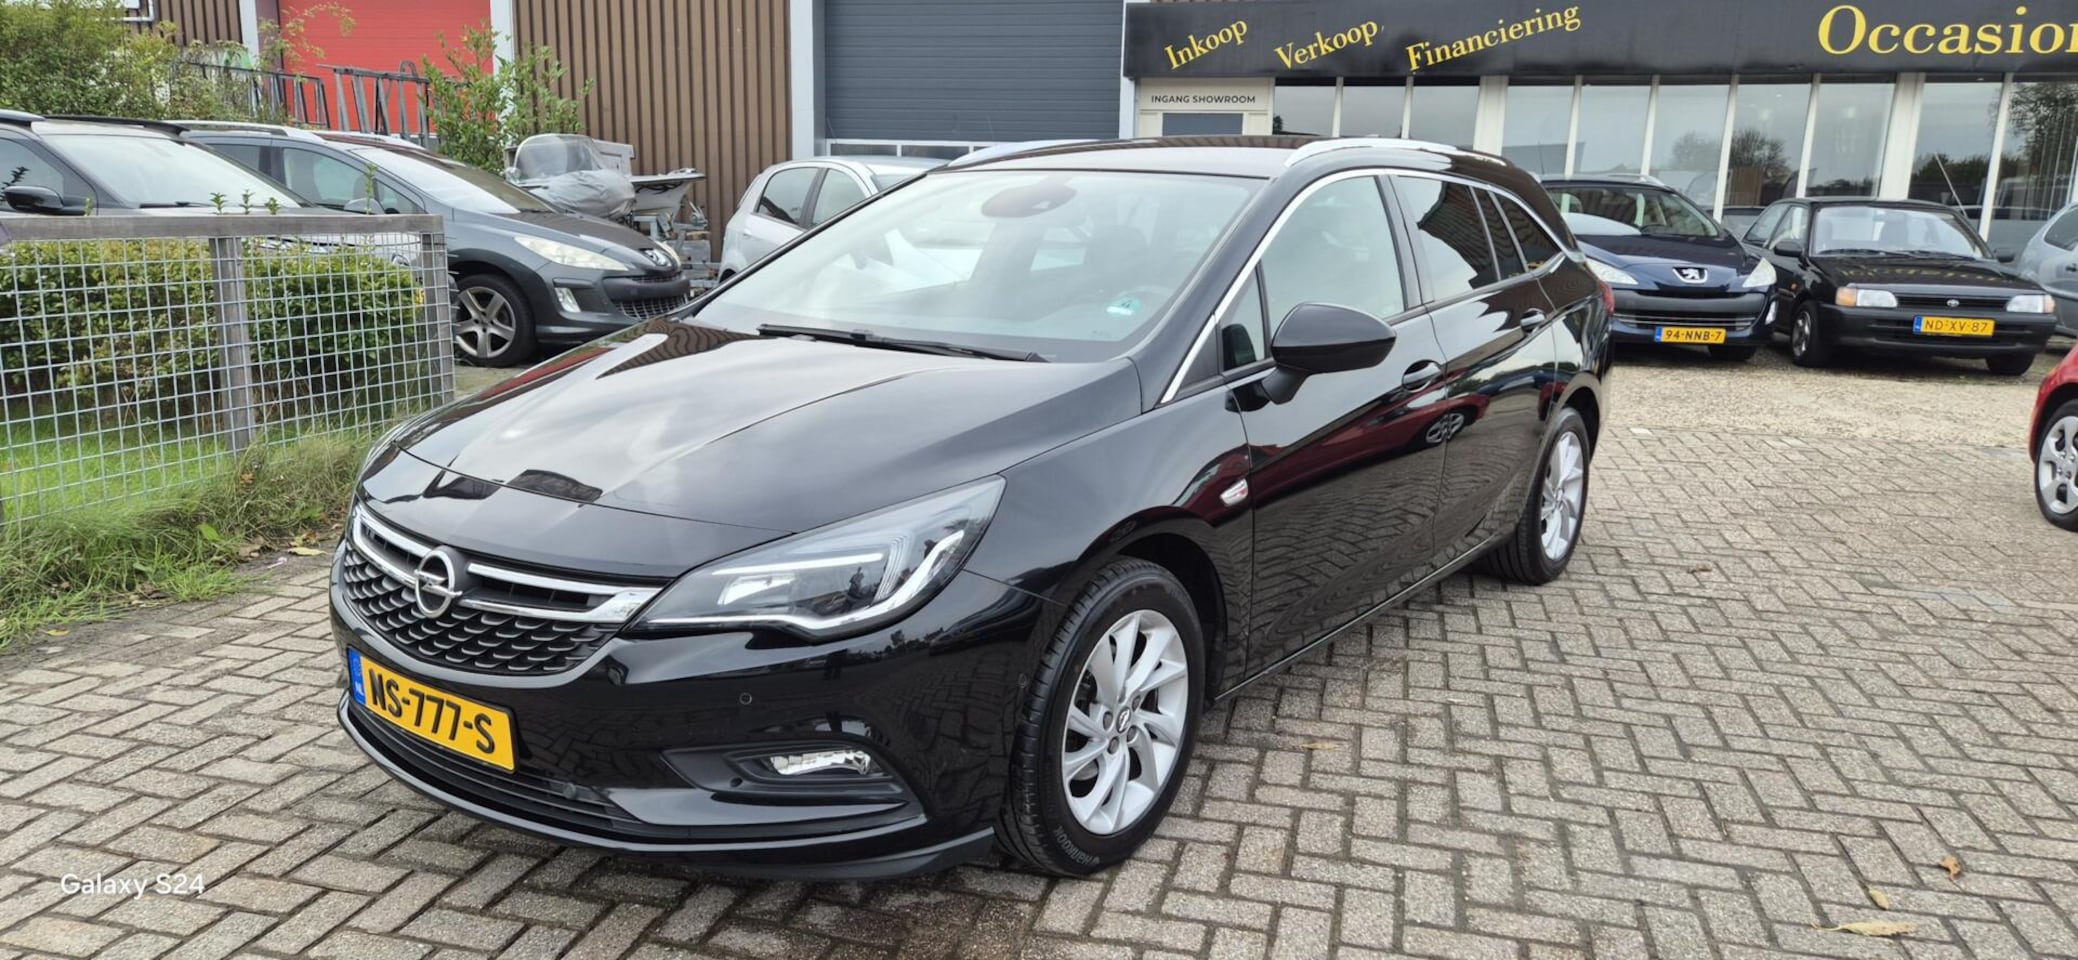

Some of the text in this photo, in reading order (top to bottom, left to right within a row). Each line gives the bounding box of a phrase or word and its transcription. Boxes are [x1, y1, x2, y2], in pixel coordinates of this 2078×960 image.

[1163, 19, 1248, 70] Inkoop
[1274, 20, 1379, 70] Verkoop
[1405, 5, 1581, 72] Financiering
[1818, 5, 2078, 54] Occasio
[1151, 95, 1256, 104] INGANG SHOWROOM
[1665, 329, 1722, 341] 94-NNB-7
[1925, 319, 1988, 333] ND-XV-87
[368, 668, 495, 754] NS-777-S
